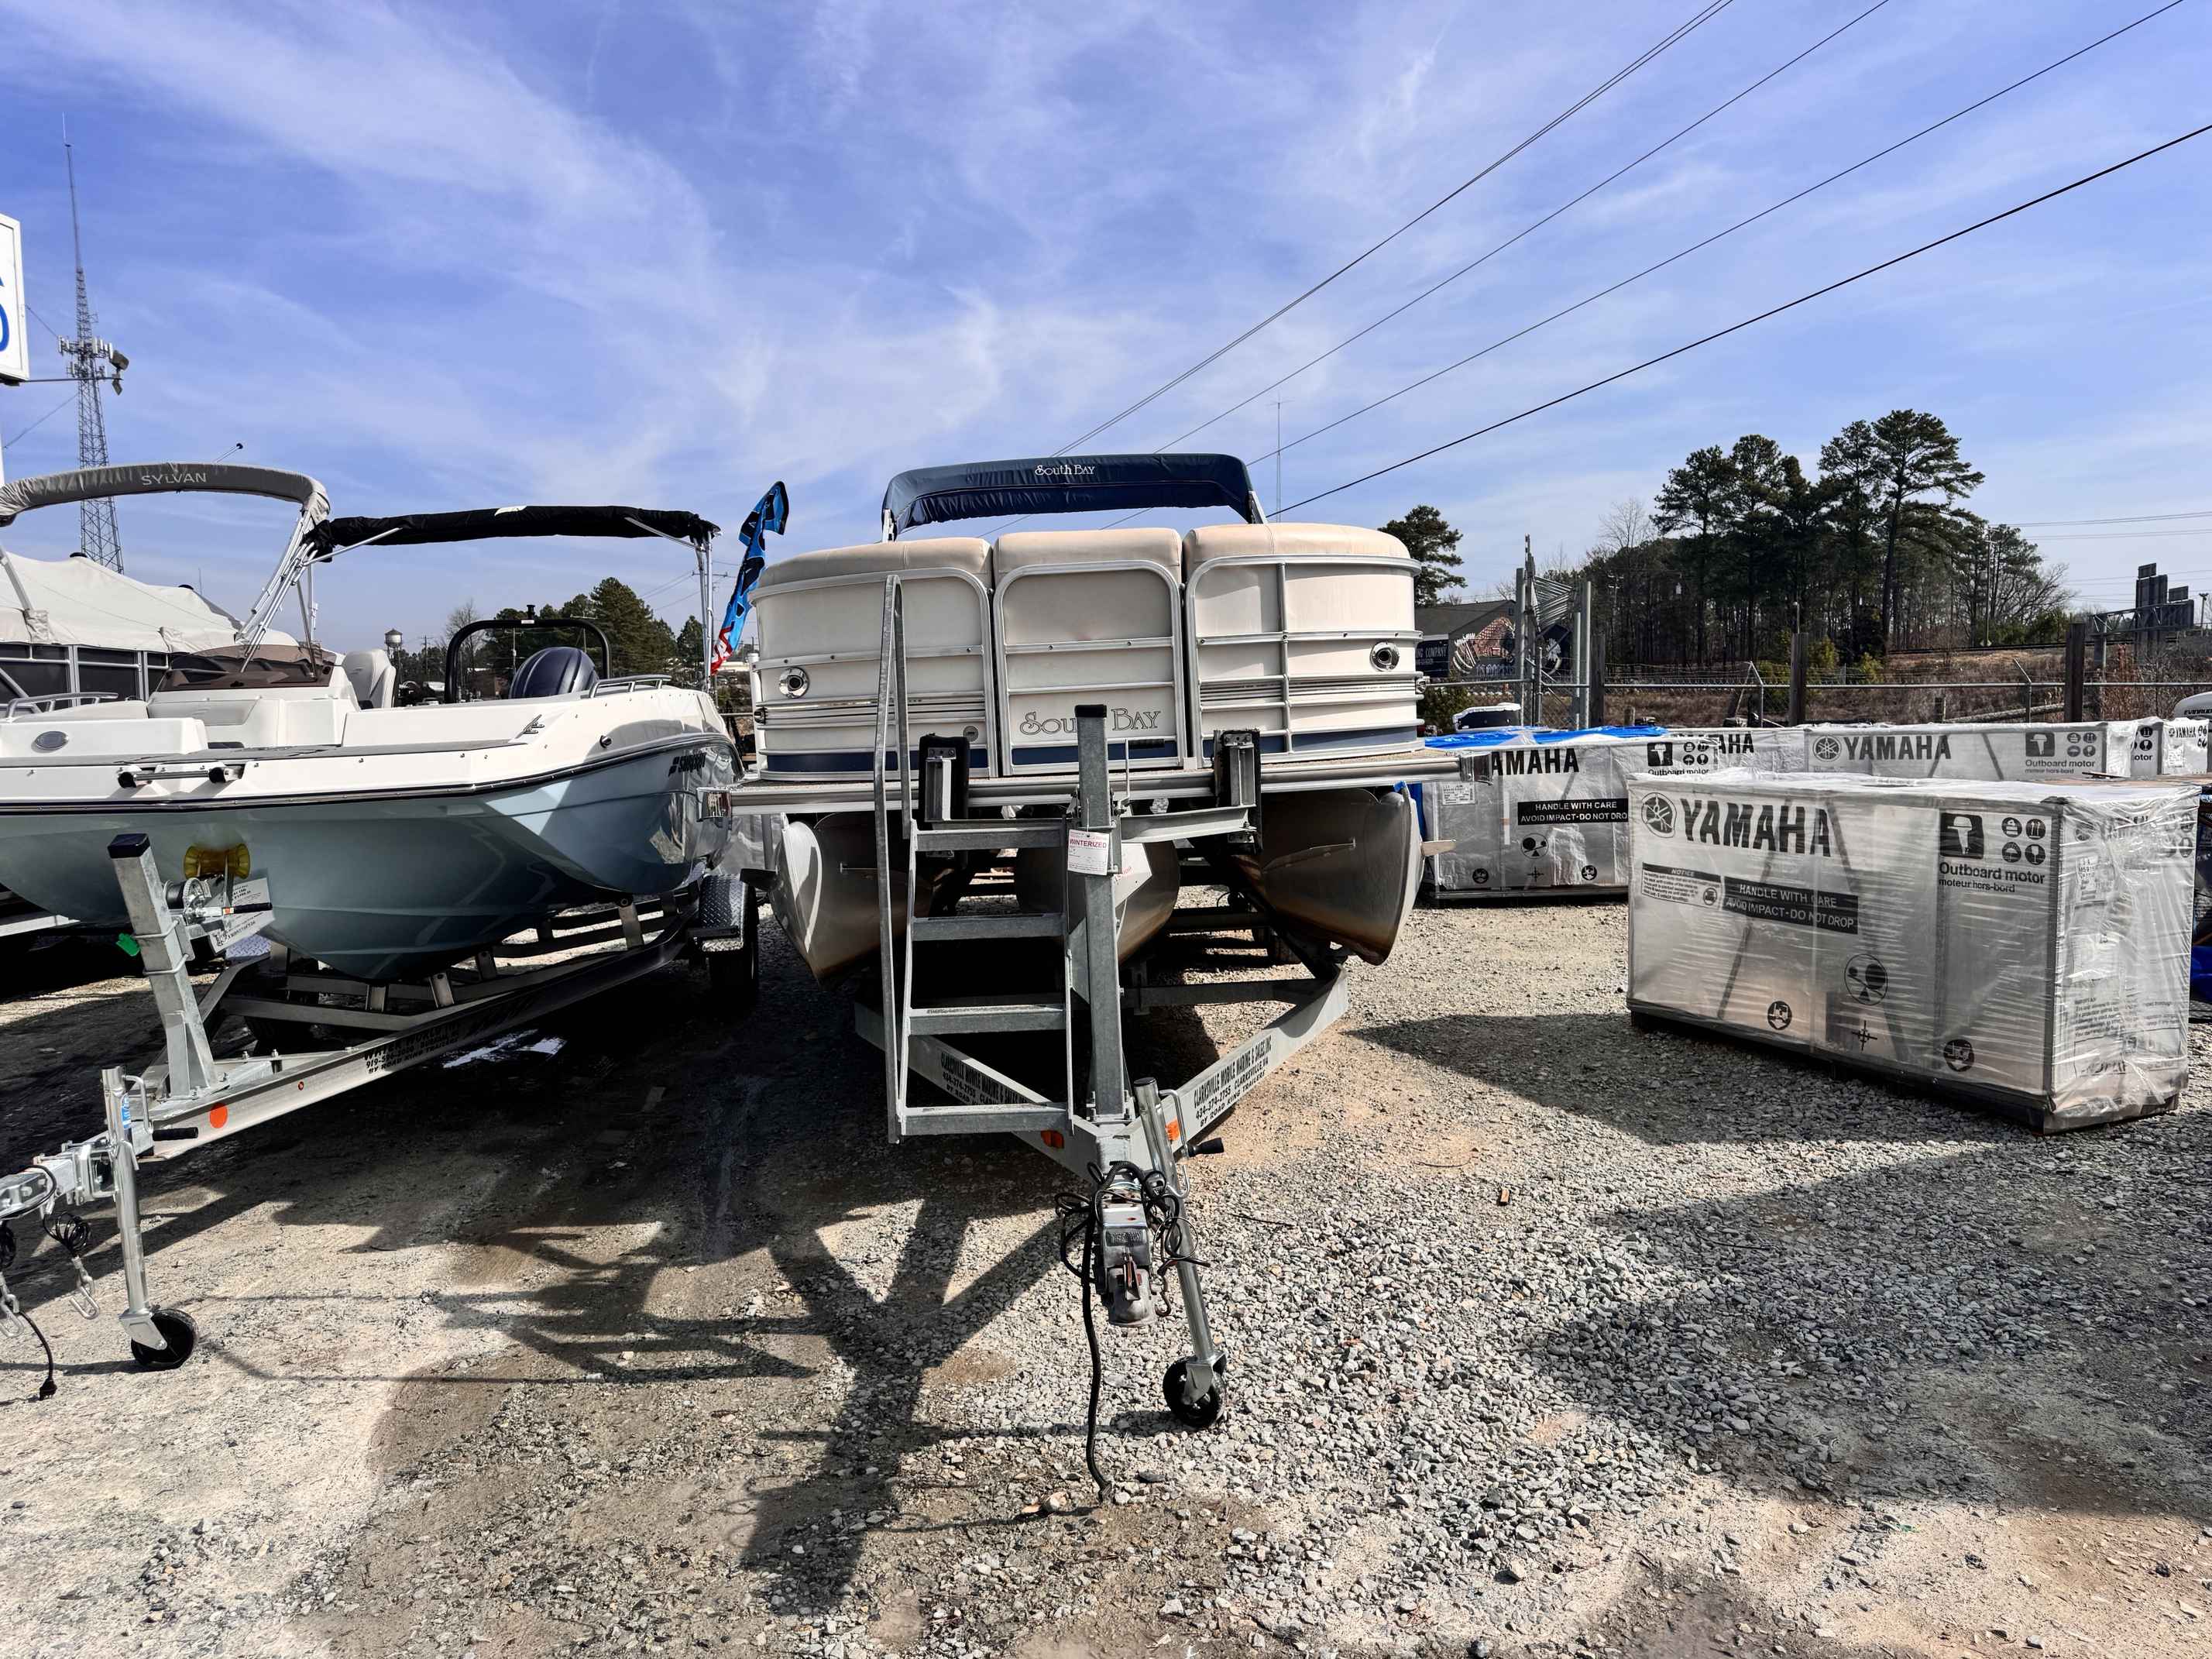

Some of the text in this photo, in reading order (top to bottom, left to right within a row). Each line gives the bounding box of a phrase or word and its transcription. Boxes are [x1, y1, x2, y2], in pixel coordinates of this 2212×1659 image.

[1035, 465, 1072, 476] South
[141, 472, 207, 486] SYLVAN
[1425, 645, 1448, 658] COMPANY
[1019, 711, 1077, 735] Sou
[2175, 726, 2197, 738] YAMAHA
[1843, 735, 1951, 761] YAMAHA
[1492, 747, 1579, 776] AMAHA
[2025, 759, 2067, 768] Outboard
[1535, 800, 1617, 811] HANDLE WITH CARE
[1520, 814, 1545, 823] AVOID
[1592, 812, 1610, 820] NOT
[1611, 811, 1627, 819] DRO
[1679, 798, 1831, 857] YAMAHA
[1070, 838, 1107, 849] WINTERIZED
[1671, 868, 1695, 878] NOTICE
[1939, 861, 2045, 884] Outboard motor
[1939, 878, 2015, 893] moteur hors-bord
[1740, 884, 1778, 900] HANDLE
[1781, 890, 1808, 903] WITH
[1828, 915, 1854, 929] DROP
[1221, 1061, 1235, 1088] MOBILE
[1236, 1049, 1250, 1076] MARINE
[1210, 1102, 1224, 1120] ROAD
[1227, 1089, 1241, 1106] KING
[1243, 1069, 1265, 1092] TRAILERS
[1195, 1085, 1231, 1120] 434-374-2755
